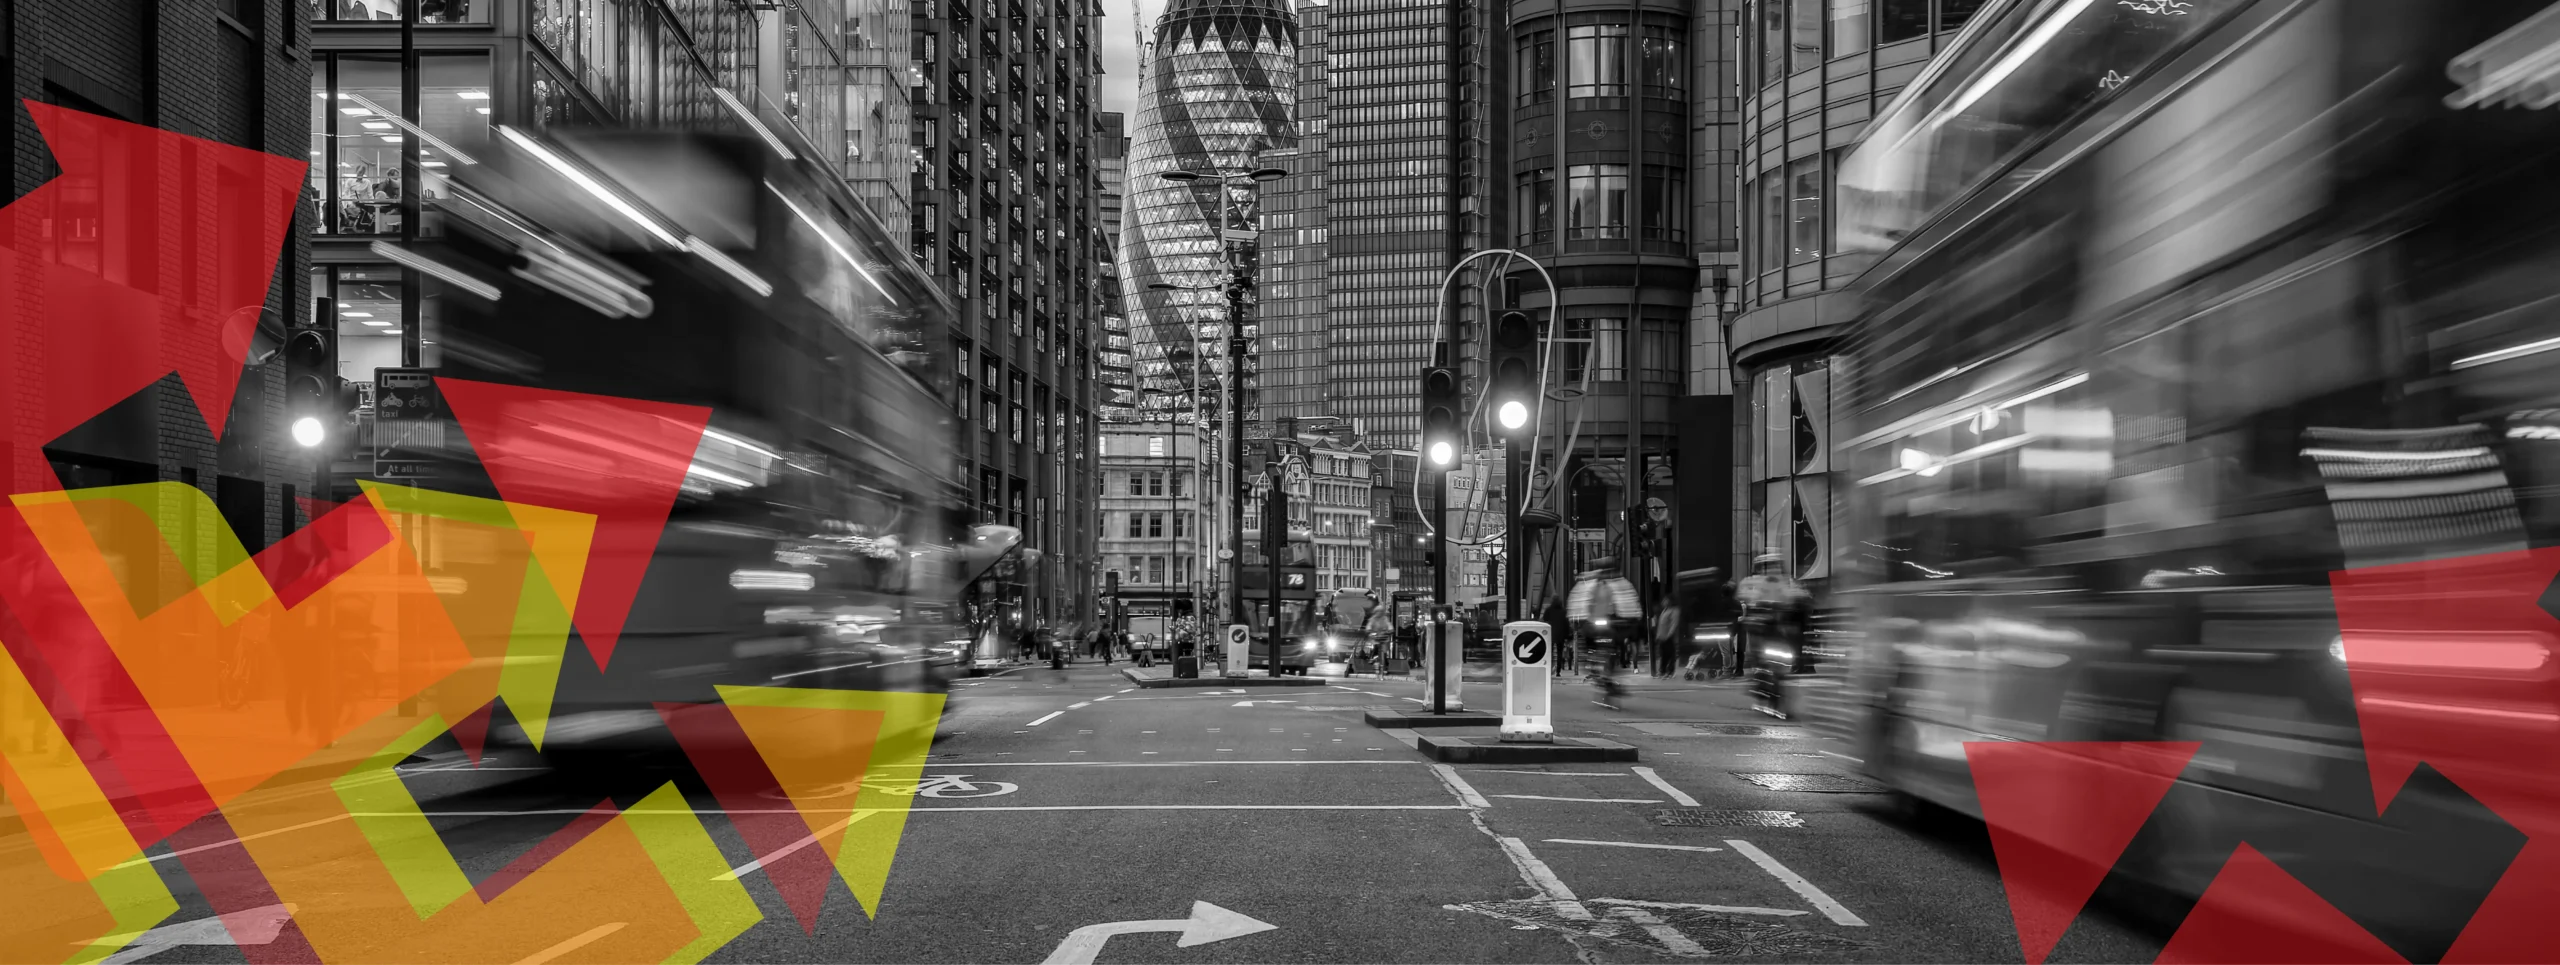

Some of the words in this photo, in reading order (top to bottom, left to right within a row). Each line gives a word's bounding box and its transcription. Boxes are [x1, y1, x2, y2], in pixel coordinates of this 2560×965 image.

[381, 409, 398, 418] taxi
[388, 464, 399, 473] At
[401, 464, 413, 473] all
[1288, 573, 1304, 585] 78
